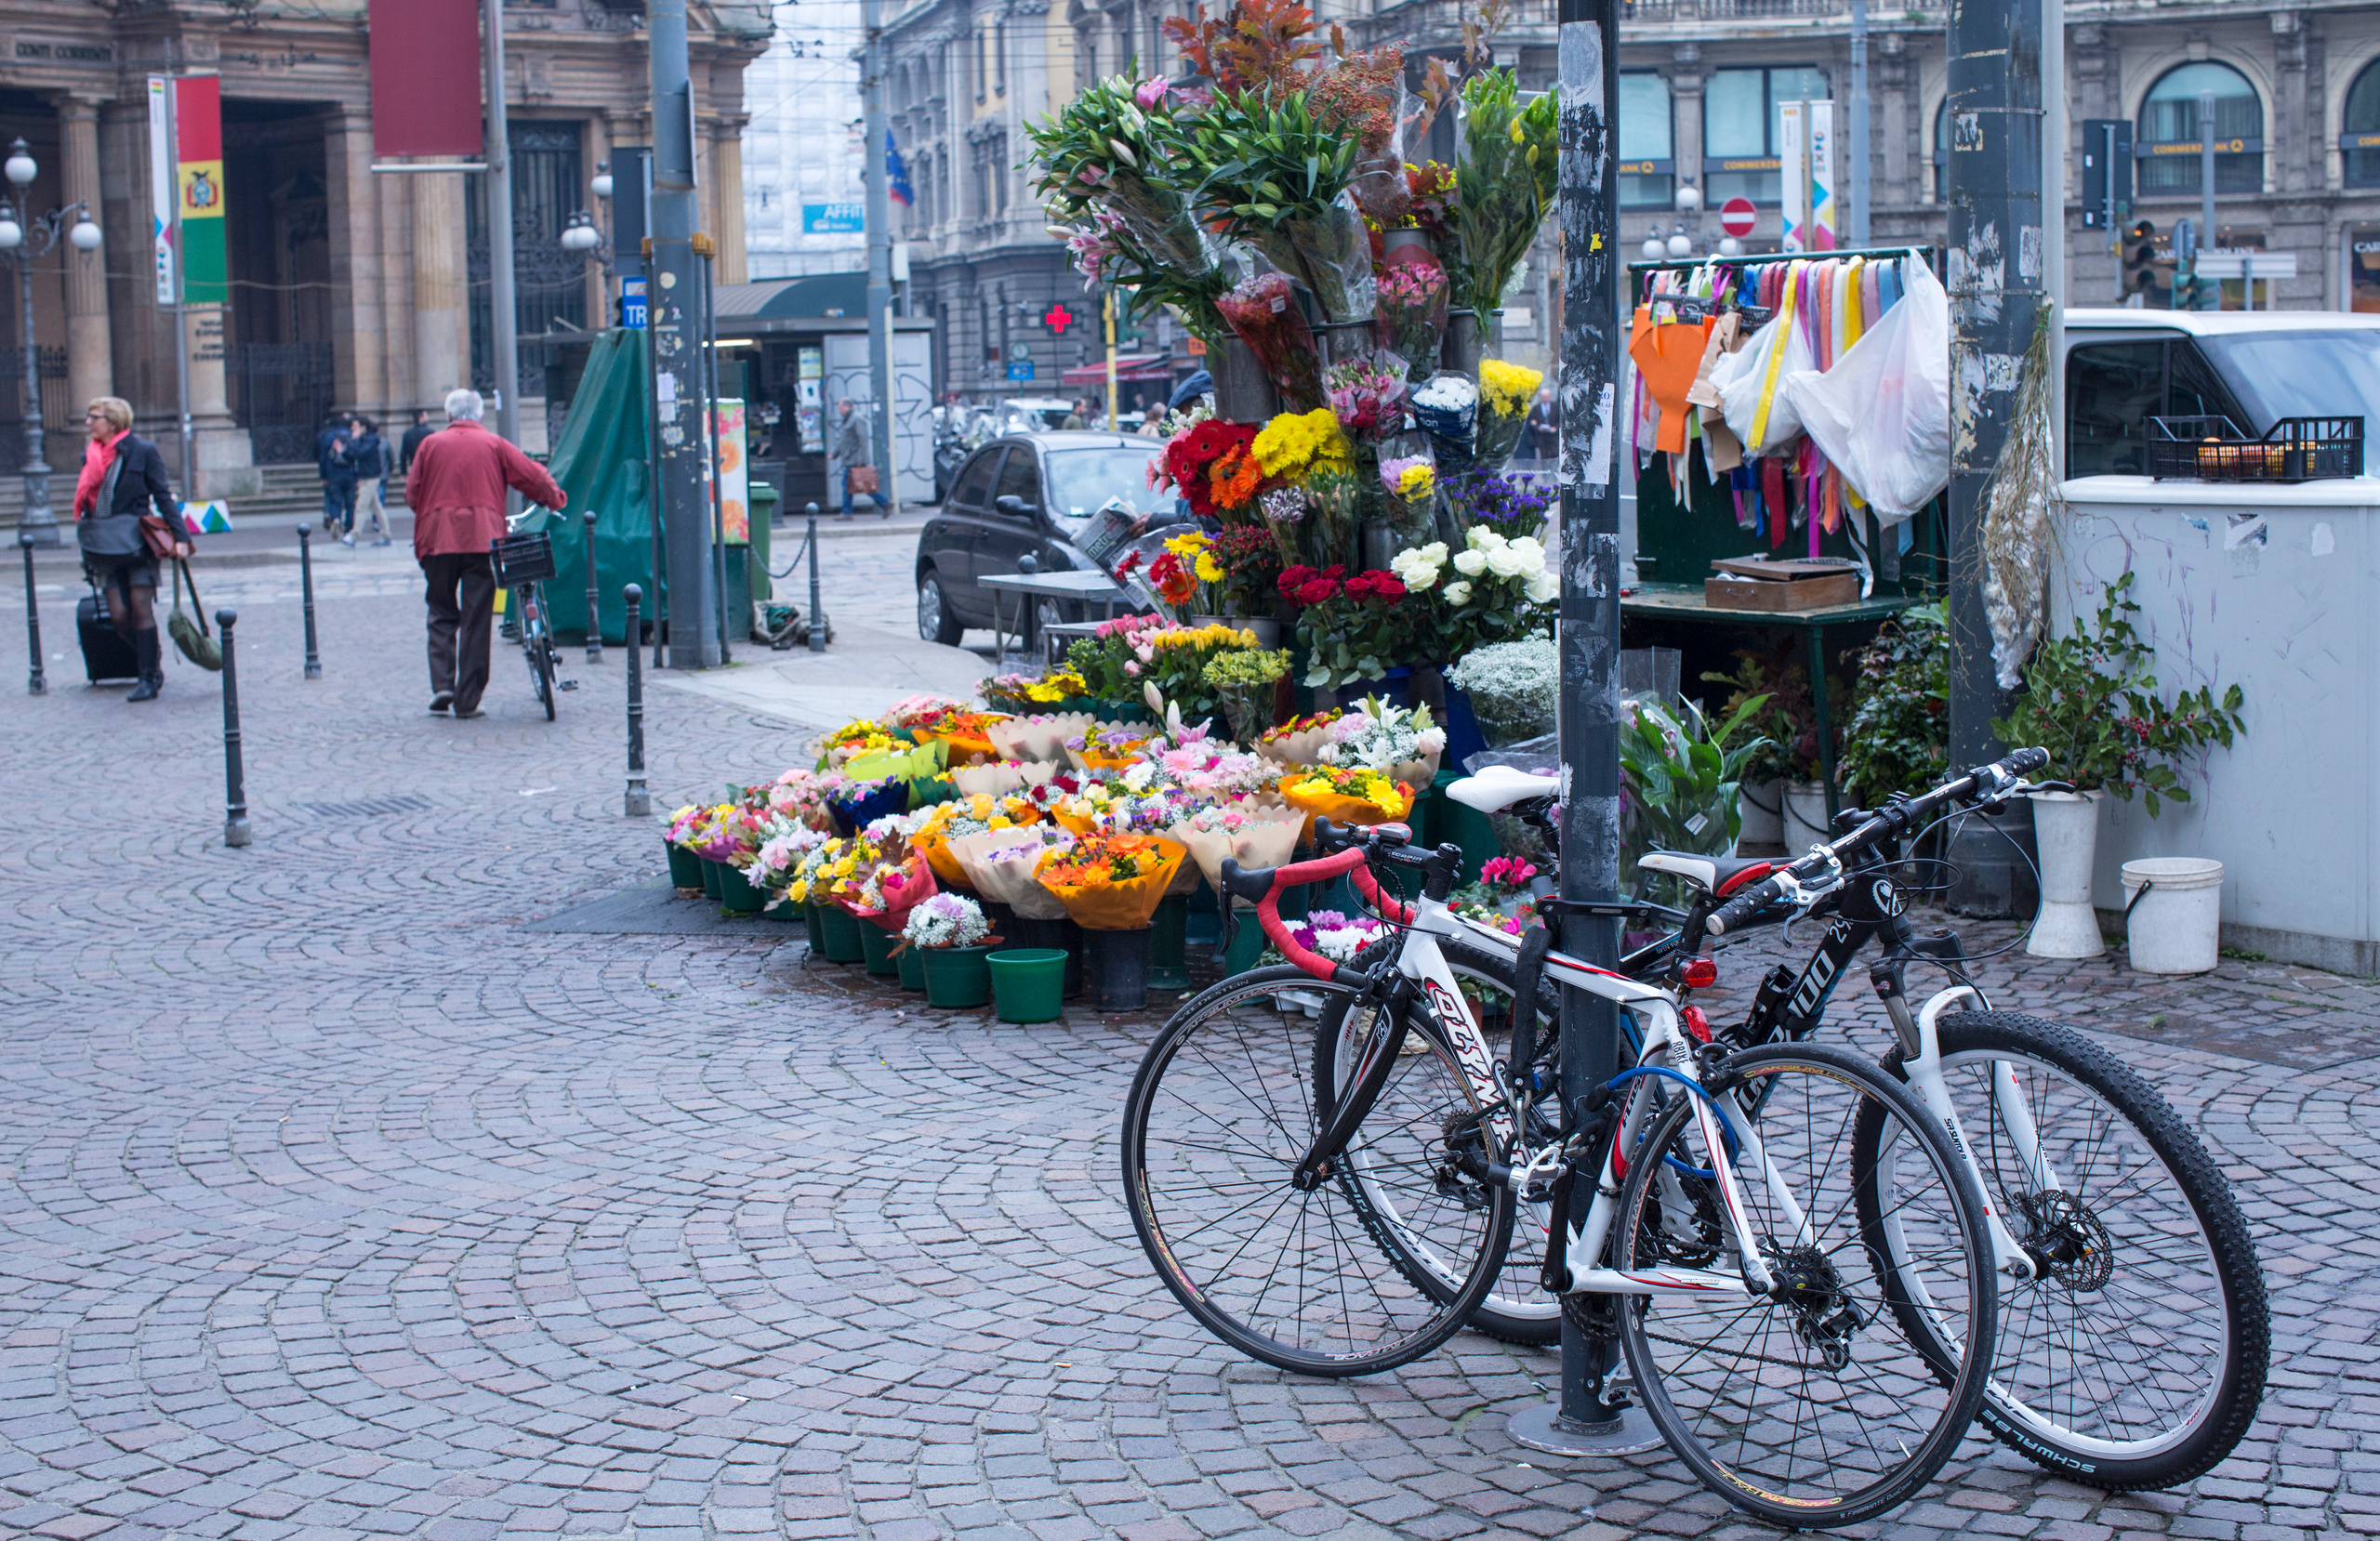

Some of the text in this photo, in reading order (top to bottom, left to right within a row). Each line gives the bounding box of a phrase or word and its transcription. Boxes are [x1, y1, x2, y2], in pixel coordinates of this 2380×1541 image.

[2153, 143, 2228, 154] COMMERZNK
[1620, 164, 1640, 173] ANK
[1176, 979, 1250, 1022] VREDESTEIN
[1981, 1409, 2096, 1473] SCHWALBE
